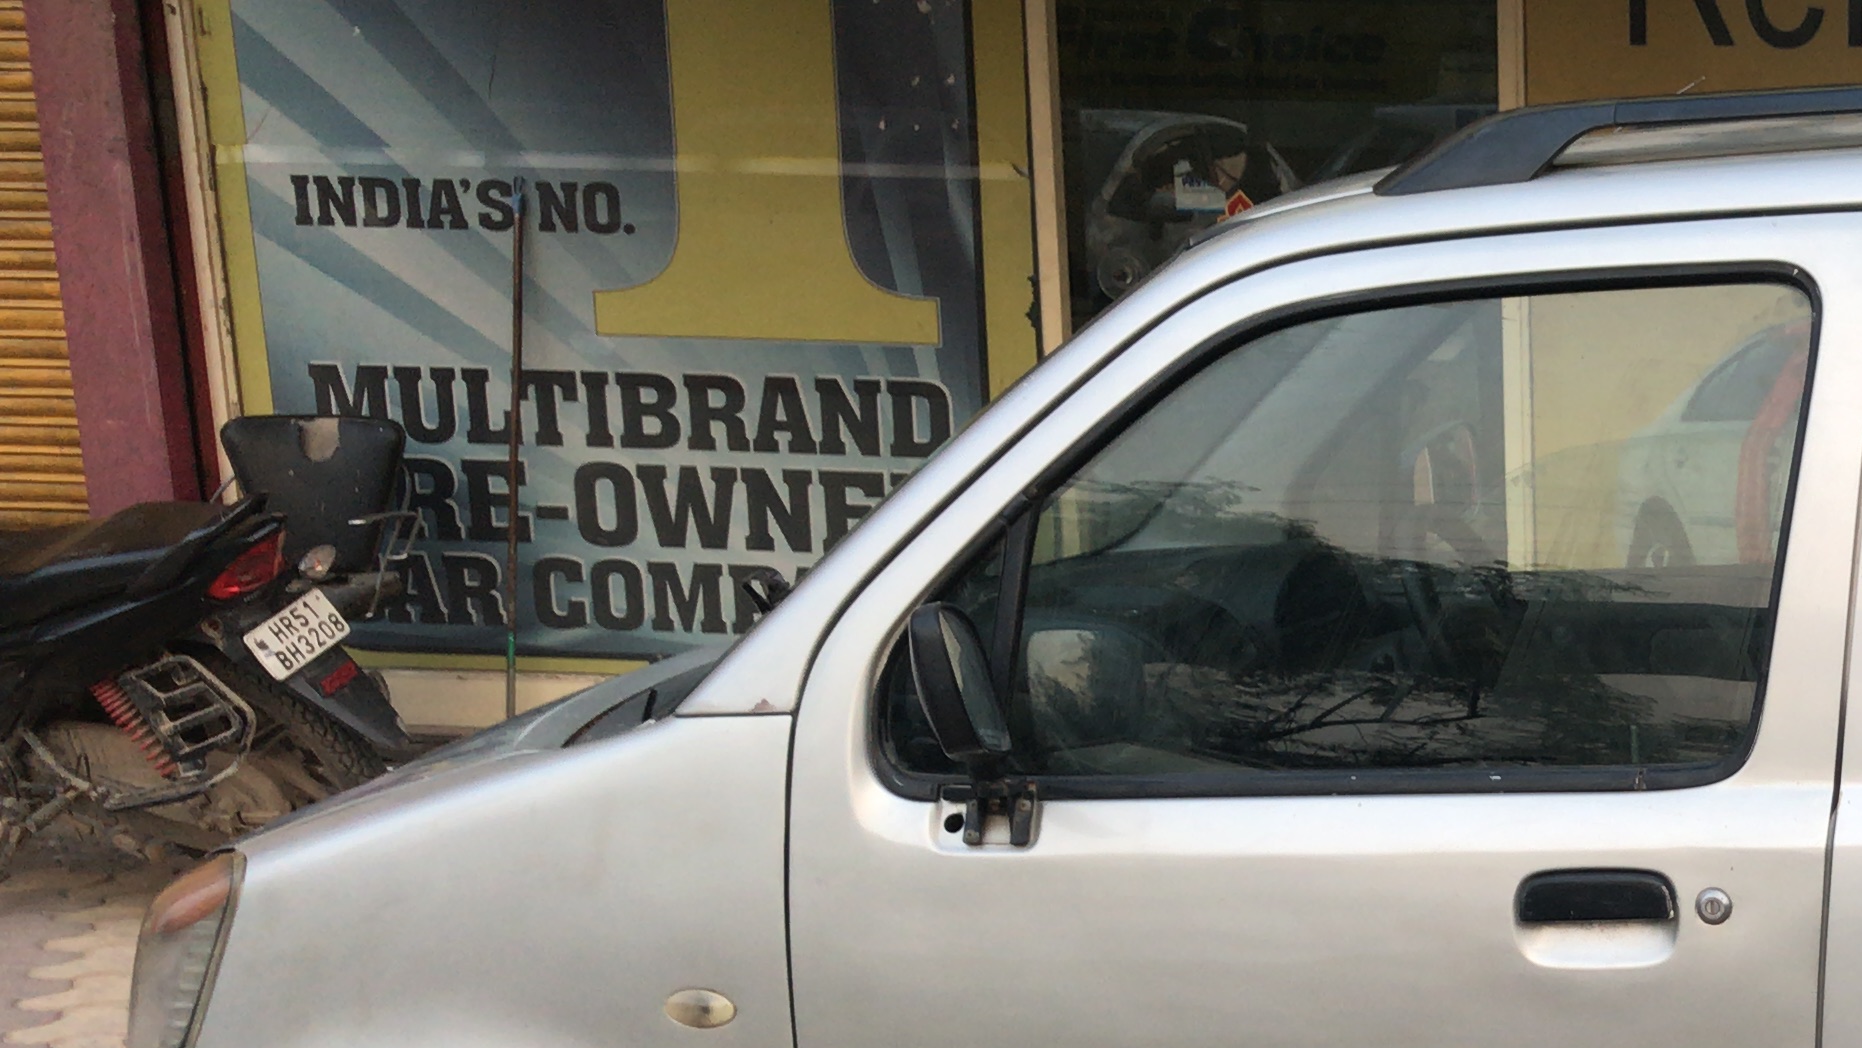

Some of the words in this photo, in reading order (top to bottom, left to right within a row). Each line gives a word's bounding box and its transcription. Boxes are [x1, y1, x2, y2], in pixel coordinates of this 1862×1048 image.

[290, 174, 516, 232] INDIA'S
[535, 181, 636, 235] NO.
[307, 362, 952, 458] MULTIBRAND
[396, 456, 912, 552] RE-OWNE
[384, 551, 508, 624] AR
[268, 601, 319, 644] HR51
[275, 612, 345, 671] BH3208
